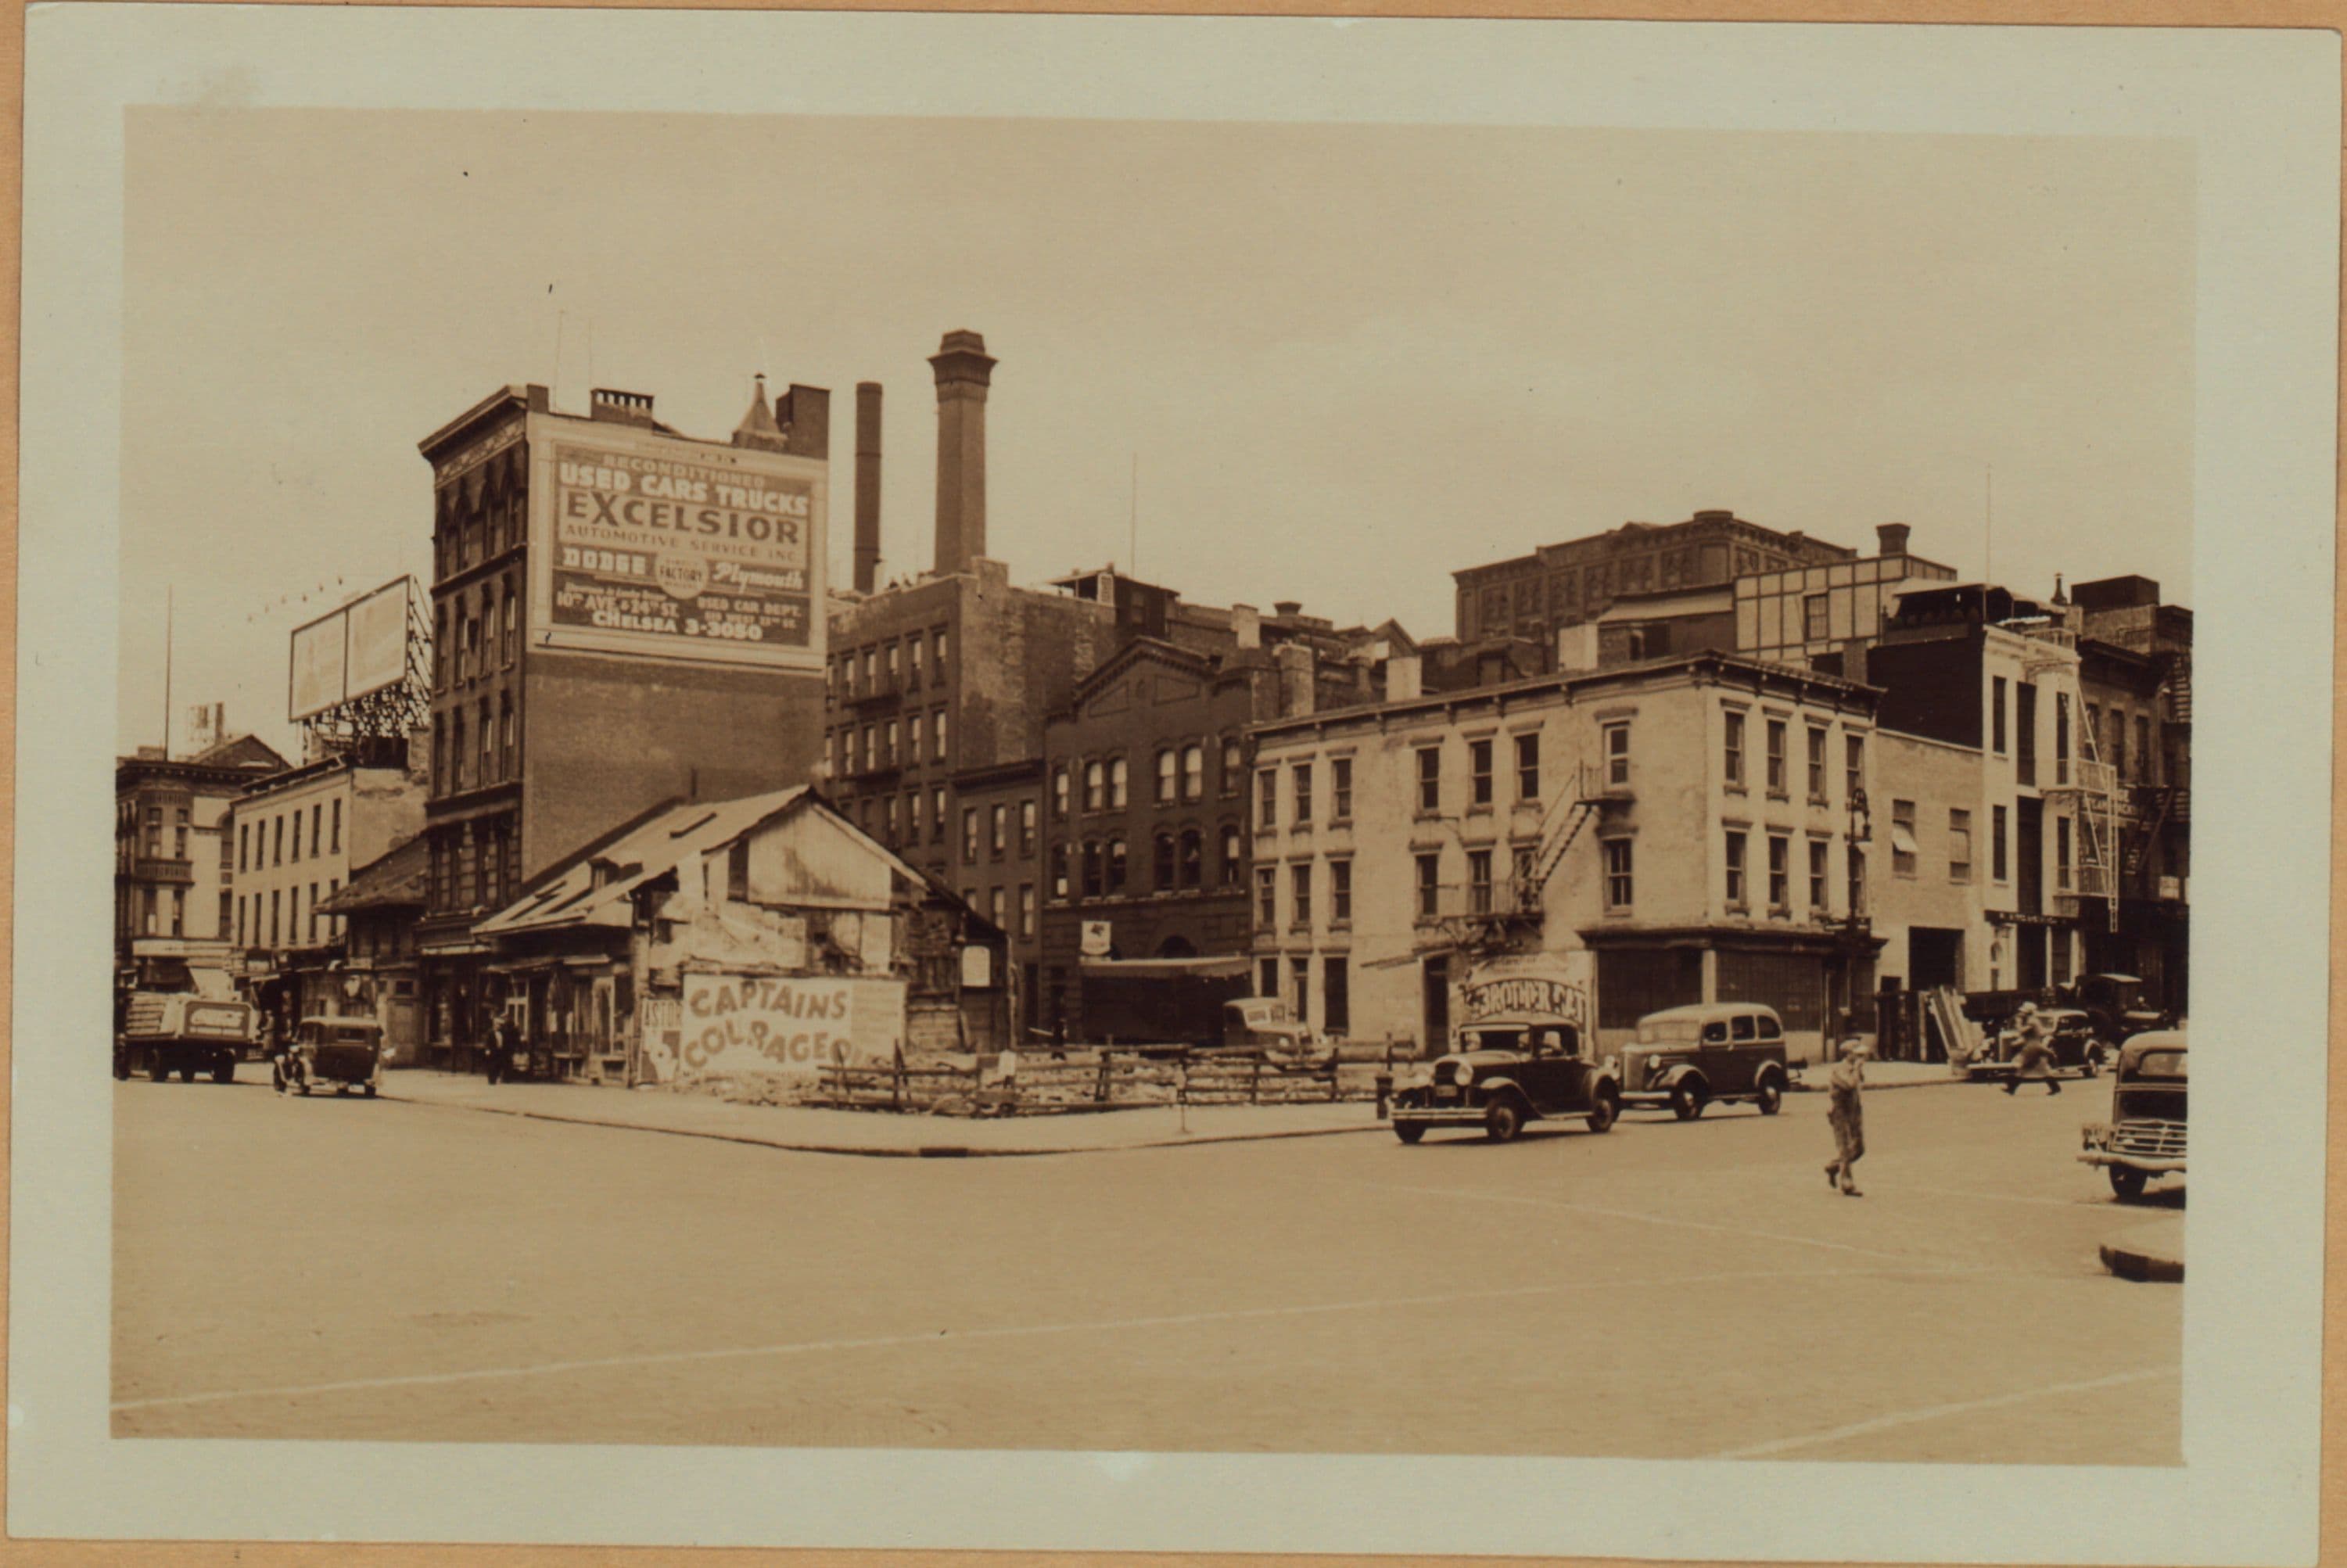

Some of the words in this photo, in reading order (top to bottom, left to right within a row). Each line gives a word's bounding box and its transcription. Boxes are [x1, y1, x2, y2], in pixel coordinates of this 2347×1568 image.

[603, 454, 765, 489] RECONDITIONED
[560, 462, 631, 491] USED
[641, 475, 708, 501] CARS
[716, 484, 808, 517] TRUCKS
[567, 490, 798, 545] EXCELSIOR
[565, 523, 676, 547] AUTOMOTIVE
[690, 537, 756, 558] SERVICE
[563, 548, 646, 575] DODGE
[712, 562, 804, 594] Plymouth
[592, 607, 678, 633] CHELSEA
[690, 981, 847, 1020] CAPTAINS
